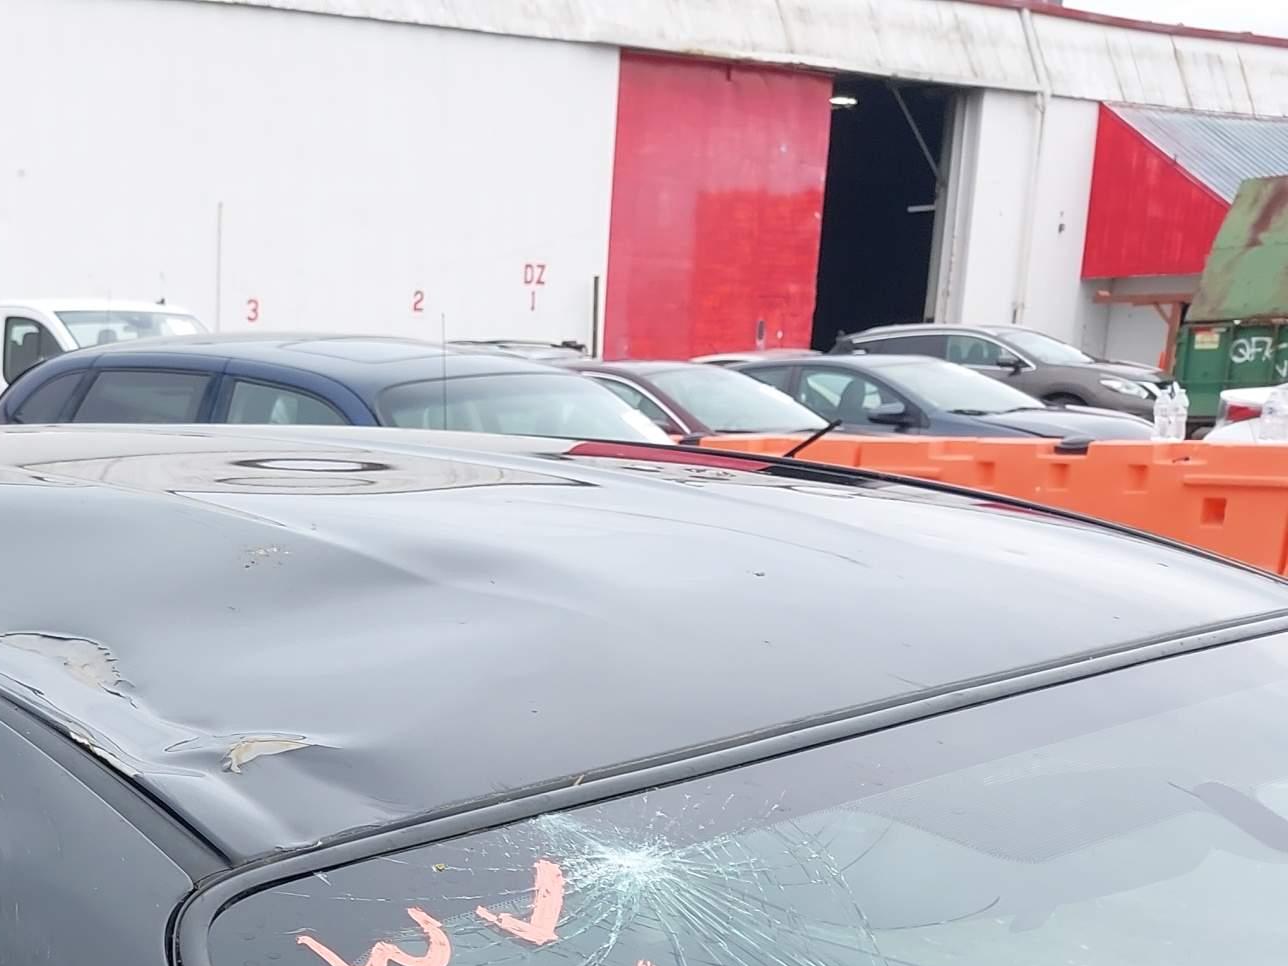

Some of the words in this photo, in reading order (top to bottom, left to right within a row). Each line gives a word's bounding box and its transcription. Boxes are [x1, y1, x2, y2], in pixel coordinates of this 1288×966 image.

[524, 263, 546, 285] DZ
[247, 298, 259, 322] 3
[413, 290, 424, 311] 2
[530, 290, 536, 311] 1
